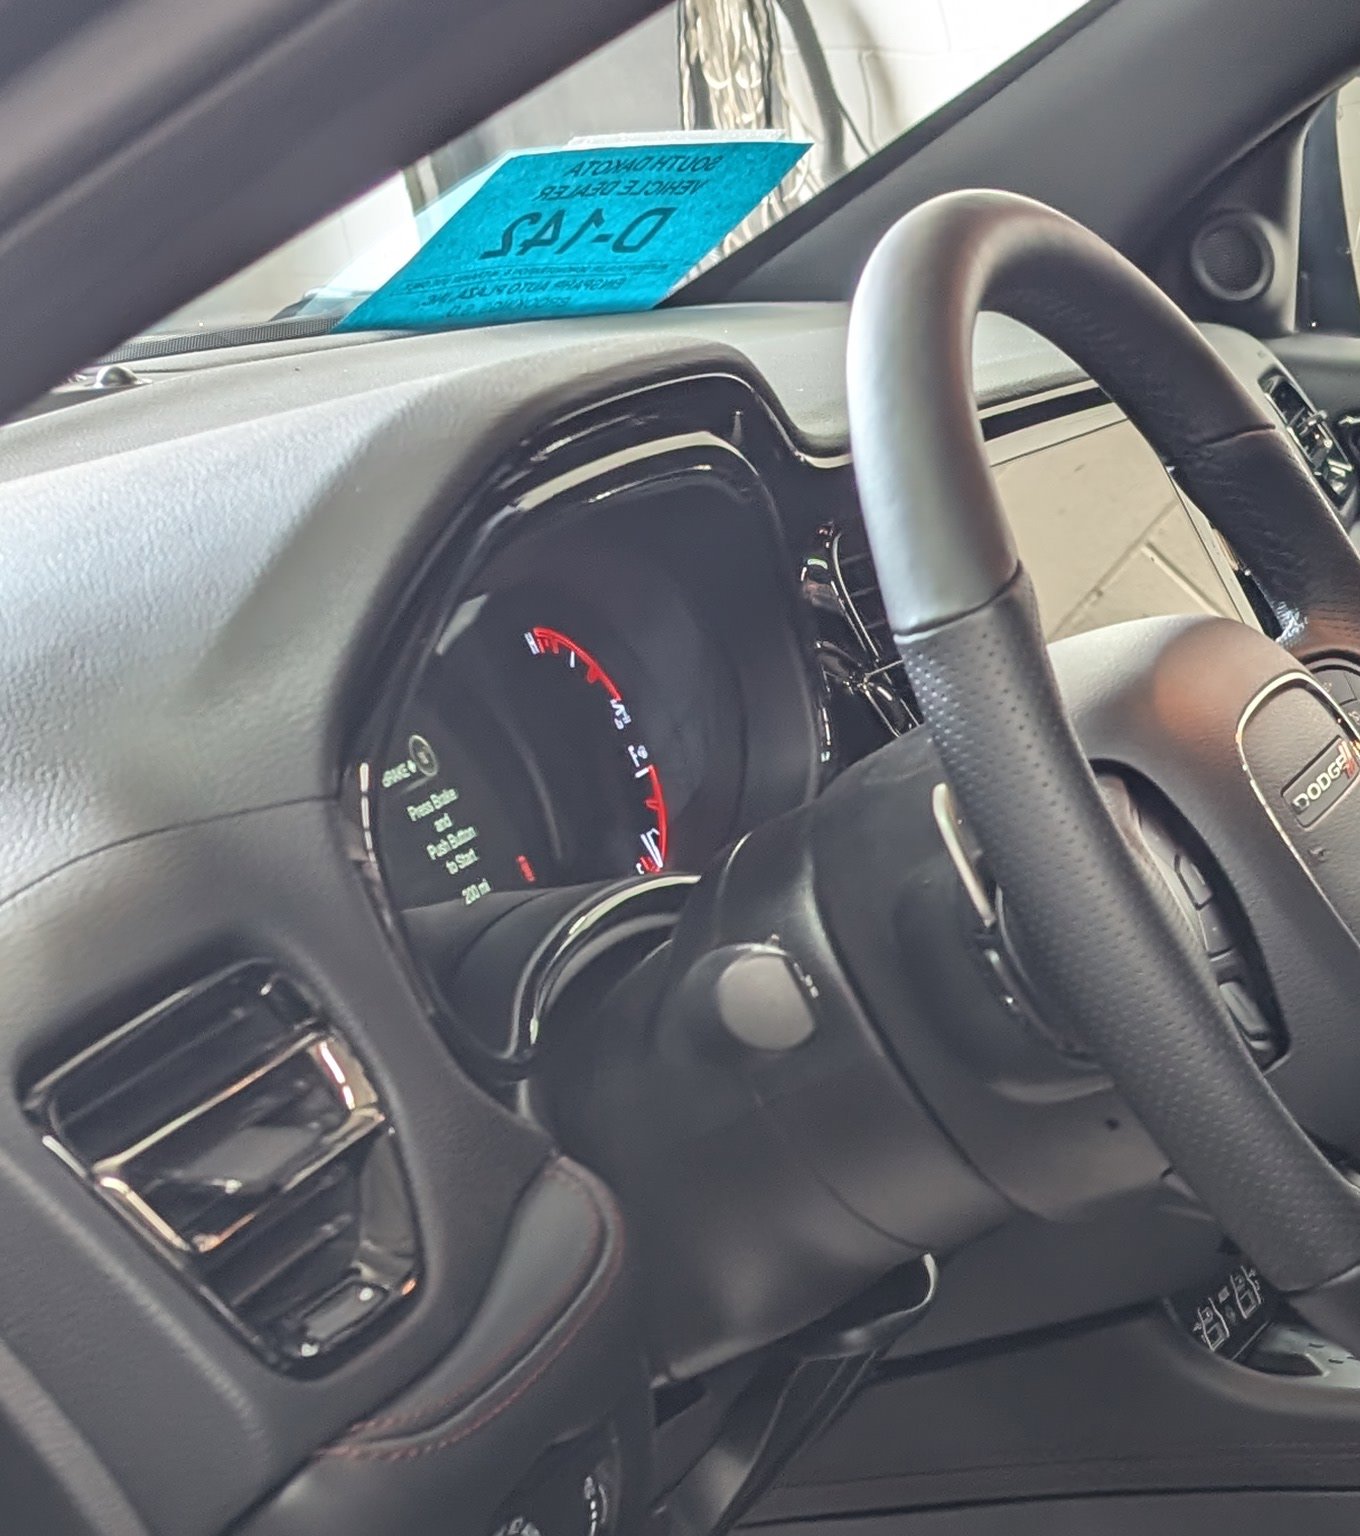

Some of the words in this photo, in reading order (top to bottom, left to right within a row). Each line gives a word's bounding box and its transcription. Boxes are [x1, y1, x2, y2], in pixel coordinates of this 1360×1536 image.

[1293, 753, 1348, 810] DODGE
[407, 800, 434, 821] Press
[430, 788, 458, 809] Brake
[434, 813, 452, 832] and
[427, 839, 451, 860] Push
[447, 827, 477, 849] Button
[446, 860, 458, 874] to
[455, 849, 480, 869] Start
